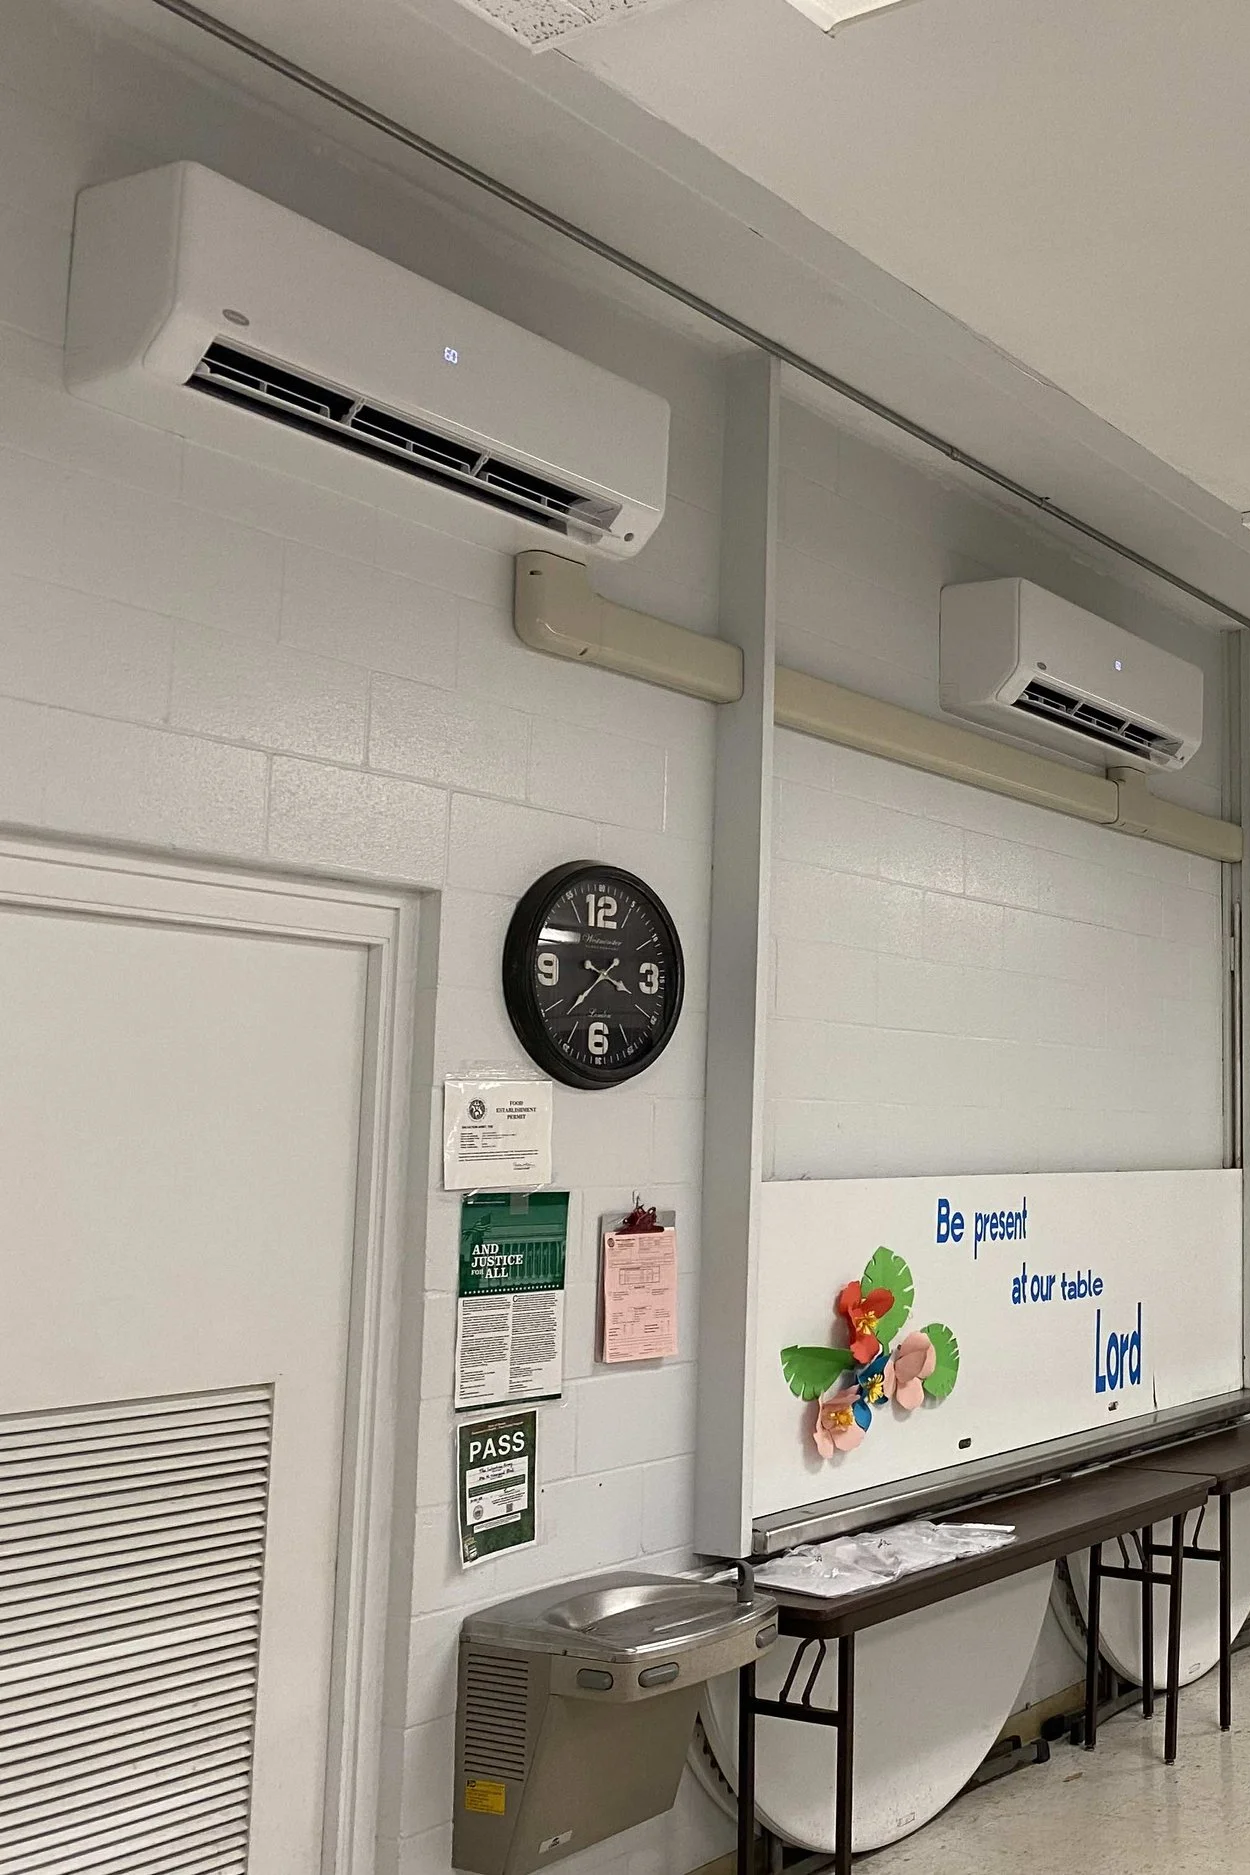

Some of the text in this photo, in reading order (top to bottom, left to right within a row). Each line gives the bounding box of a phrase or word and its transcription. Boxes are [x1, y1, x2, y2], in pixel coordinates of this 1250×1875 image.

[445, 347, 457, 363] 60
[586, 893, 617, 929] 12
[537, 952, 559, 986] 9
[639, 962, 659, 995] 3
[588, 1022, 609, 1055] 6
[937, 1196, 1027, 1260] Be present
[471, 1254, 523, 1268] JUSTICE
[472, 1243, 499, 1256] AND
[485, 1267, 508, 1278] ALL
[1012, 1262, 1103, 1304] at our table
[1095, 1302, 1141, 1393] Lord
[469, 1432, 525, 1463] PASS
